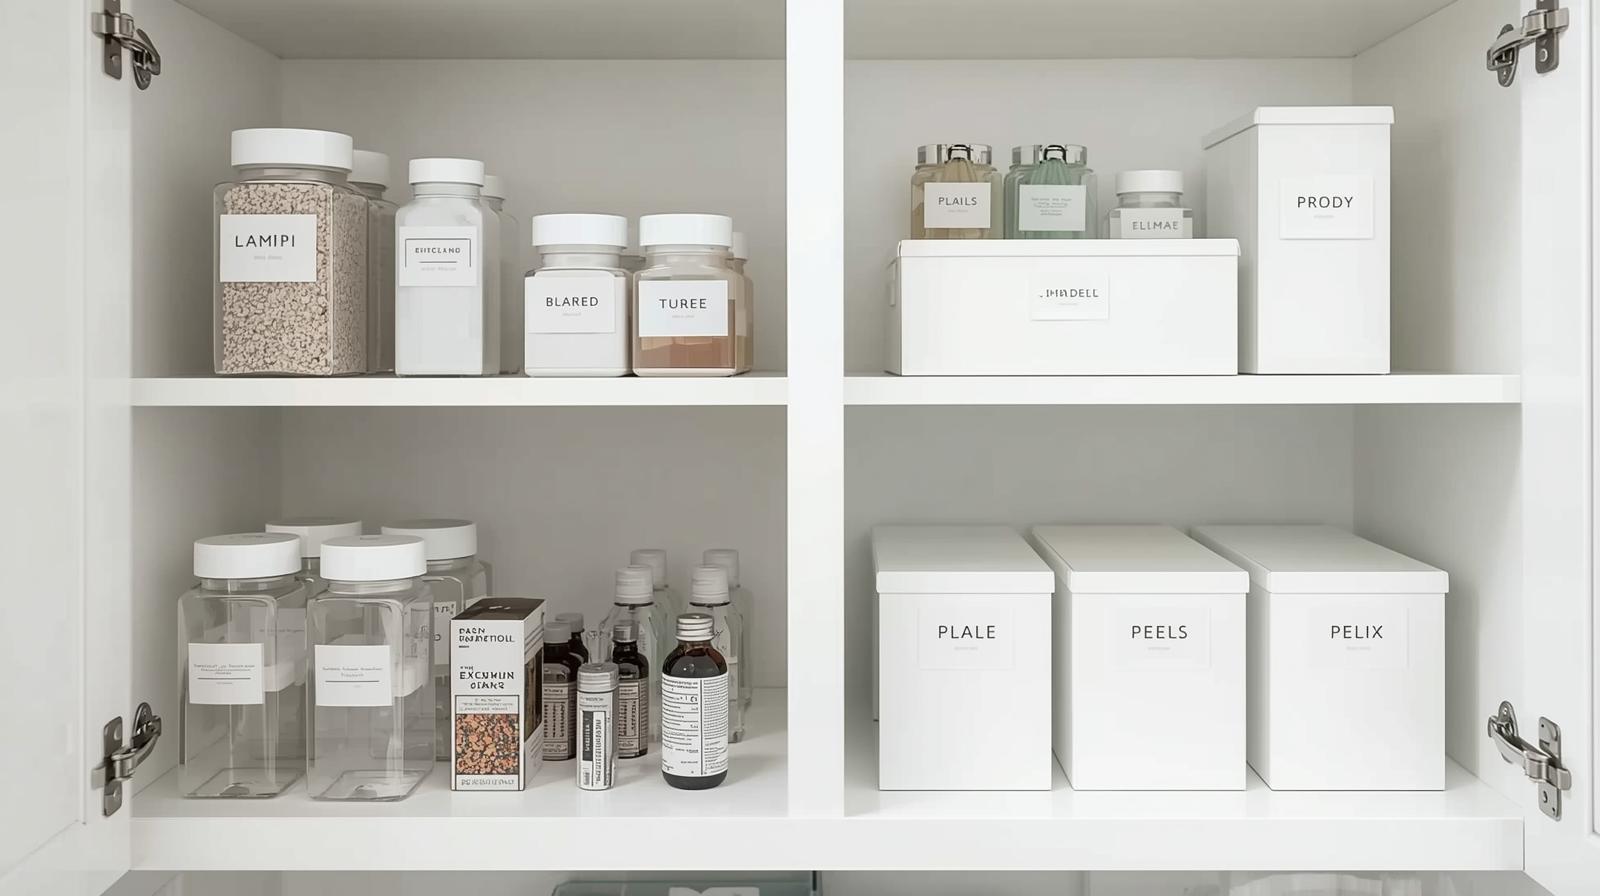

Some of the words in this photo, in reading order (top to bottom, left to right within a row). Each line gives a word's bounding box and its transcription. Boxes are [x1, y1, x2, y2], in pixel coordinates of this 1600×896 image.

[938, 196, 978, 206] PLAILS
[1297, 195, 1354, 209] PRODY
[235, 234, 295, 248] LAMIPI
[545, 296, 599, 307] BLARED
[658, 298, 707, 310] TUREE
[938, 625, 996, 639] PLALE
[1131, 625, 1188, 639] PEELS
[1330, 625, 1384, 639] PELIX
